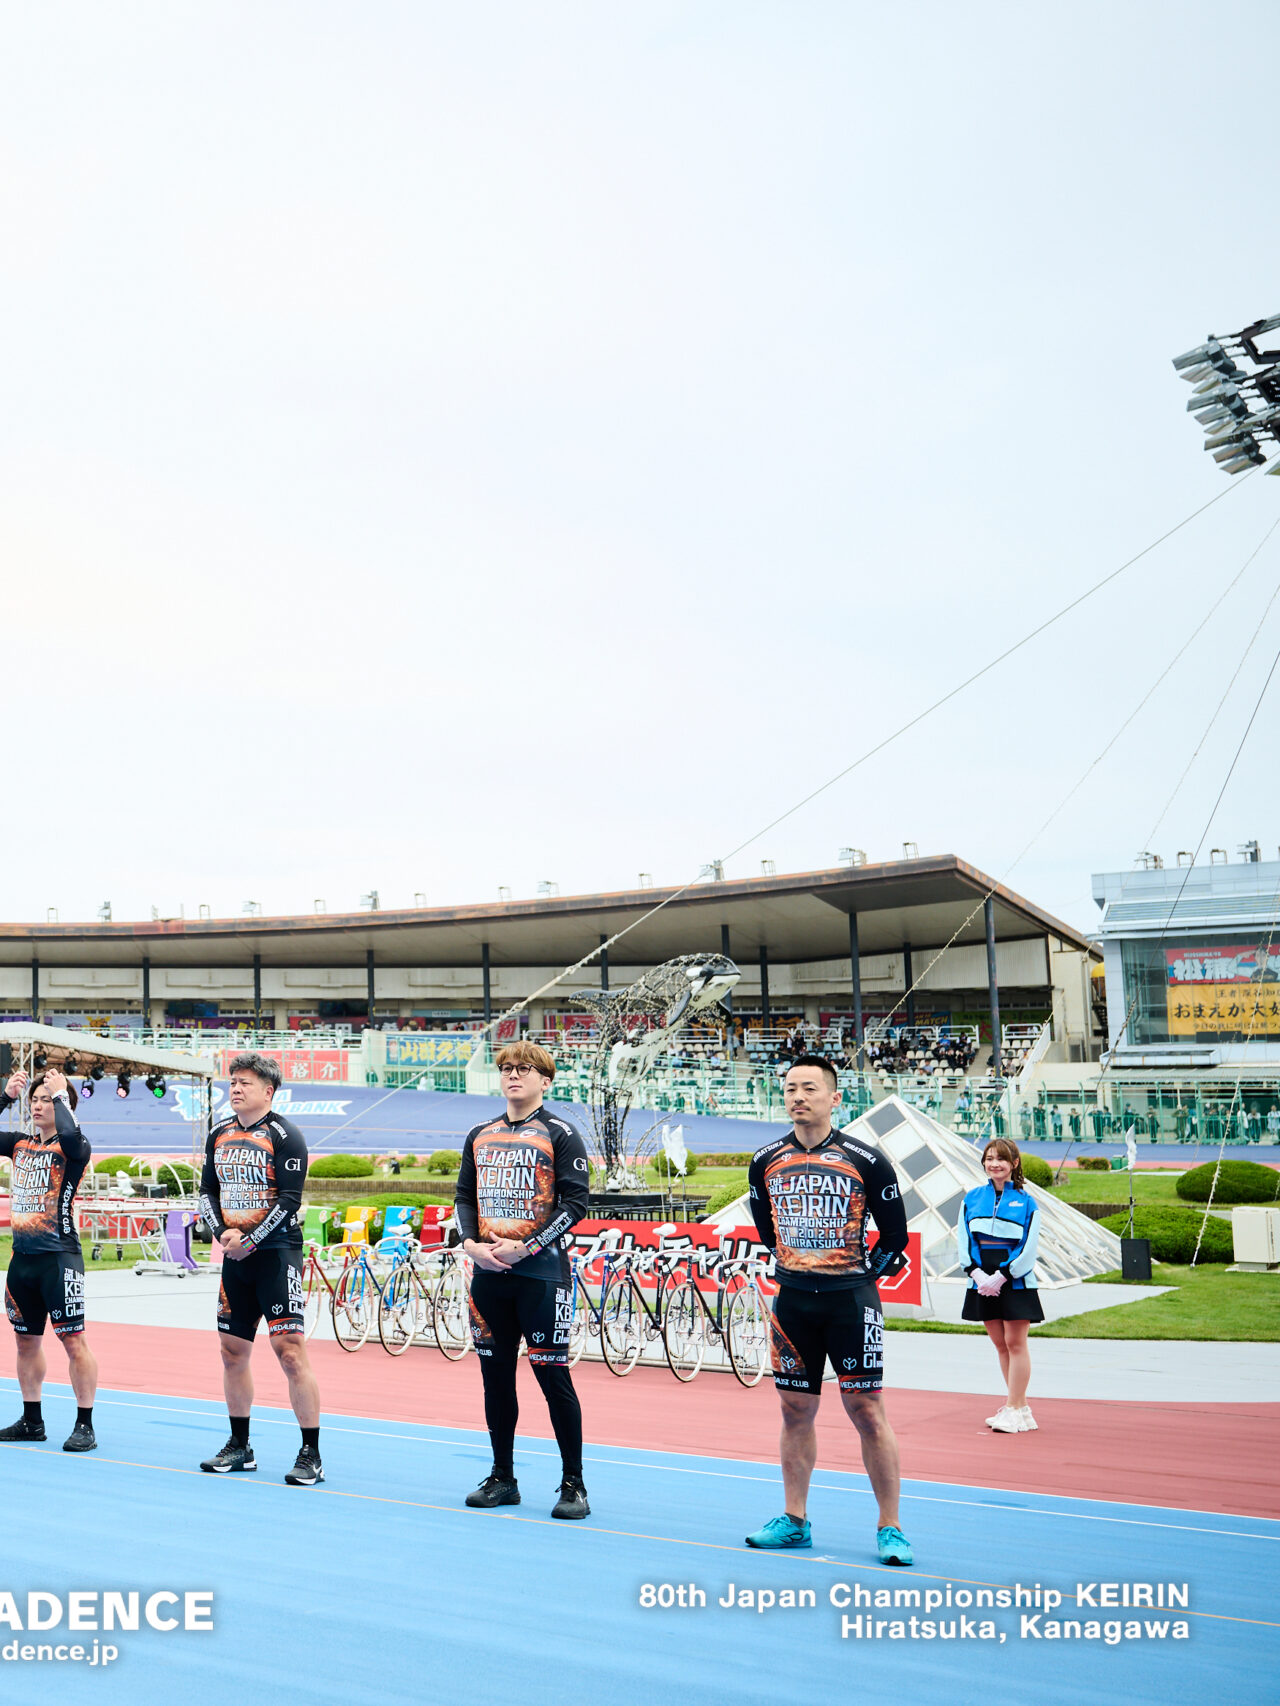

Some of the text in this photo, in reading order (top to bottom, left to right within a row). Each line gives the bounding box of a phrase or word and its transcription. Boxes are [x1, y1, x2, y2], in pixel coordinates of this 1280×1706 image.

[225, 1148, 267, 1167] JAPAN
[487, 1148, 537, 1167] JAPAN
[753, 1141, 784, 1163] HIRATSUKA
[843, 1141, 877, 1165] HIRATSUKA
[23, 1152, 53, 1170] JAPAN
[215, 1164, 268, 1184] KEIRIN
[478, 1167, 536, 1190] KEIRIN
[769, 1177, 784, 1185] THE
[784, 1175, 851, 1195] JAPAN
[478, 1188, 535, 1200] HAMPIONSHIP
[493, 1199, 525, 1209] 2026
[772, 1195, 851, 1218] KEIRIN
[398, 1209, 408, 1221] 4
[436, 1207, 445, 1220] 3
[487, 1207, 536, 1220] HIRATSUKA
[778, 1217, 848, 1229] CHAMPIONSHIP
[798, 1228, 837, 1239] 2026
[790, 1238, 846, 1249] HIRATSUKA
[791, 1379, 810, 1388] CLUB
[840, 1381, 871, 1389] MEDALIST
